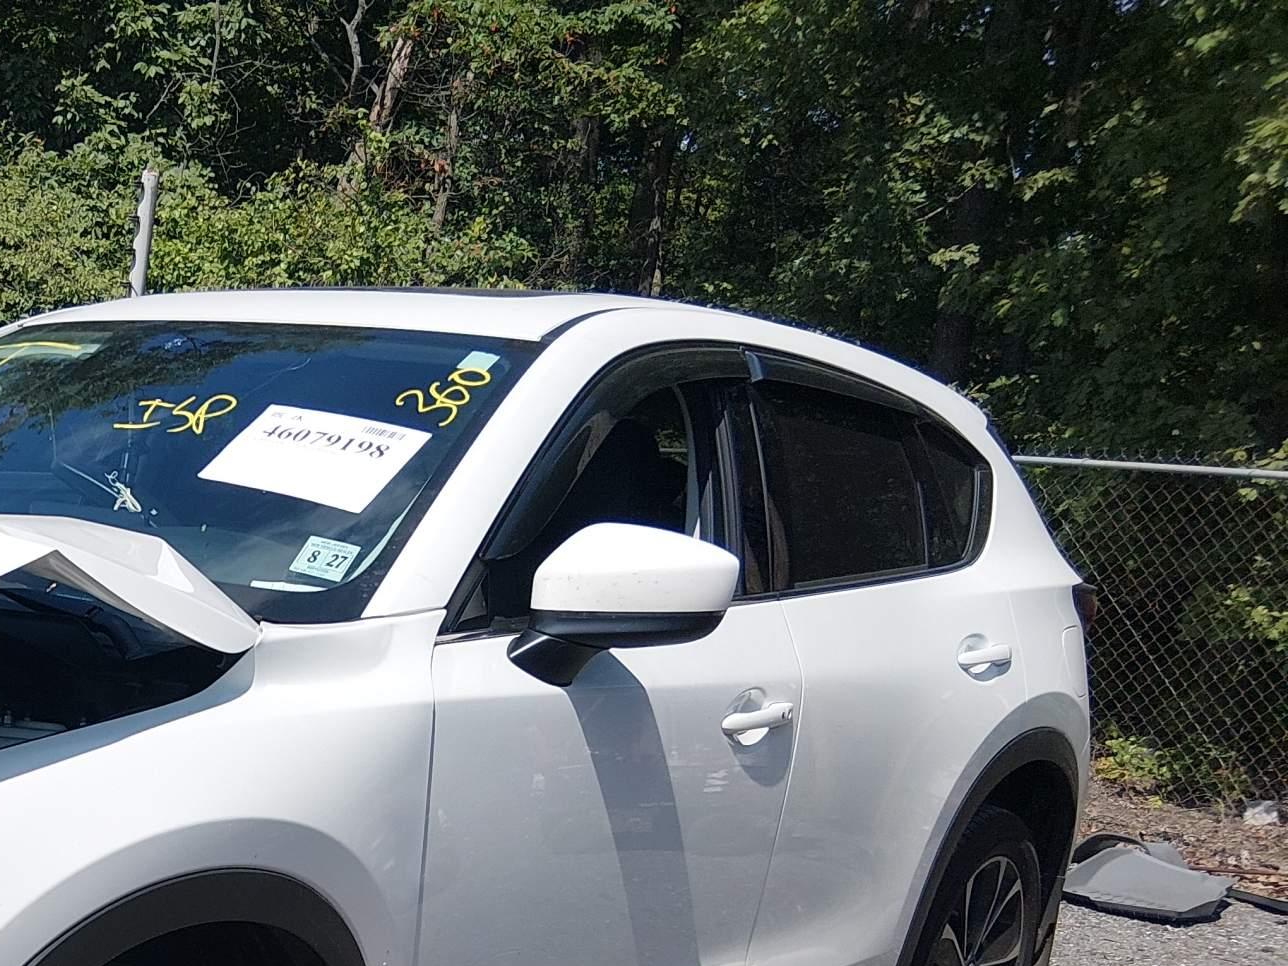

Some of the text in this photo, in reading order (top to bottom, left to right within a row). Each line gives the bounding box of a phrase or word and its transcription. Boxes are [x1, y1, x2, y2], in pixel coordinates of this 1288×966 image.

[395, 367, 492, 428] 360
[262, 425, 390, 459] 46079198
[306, 550, 349, 569] 8 27
